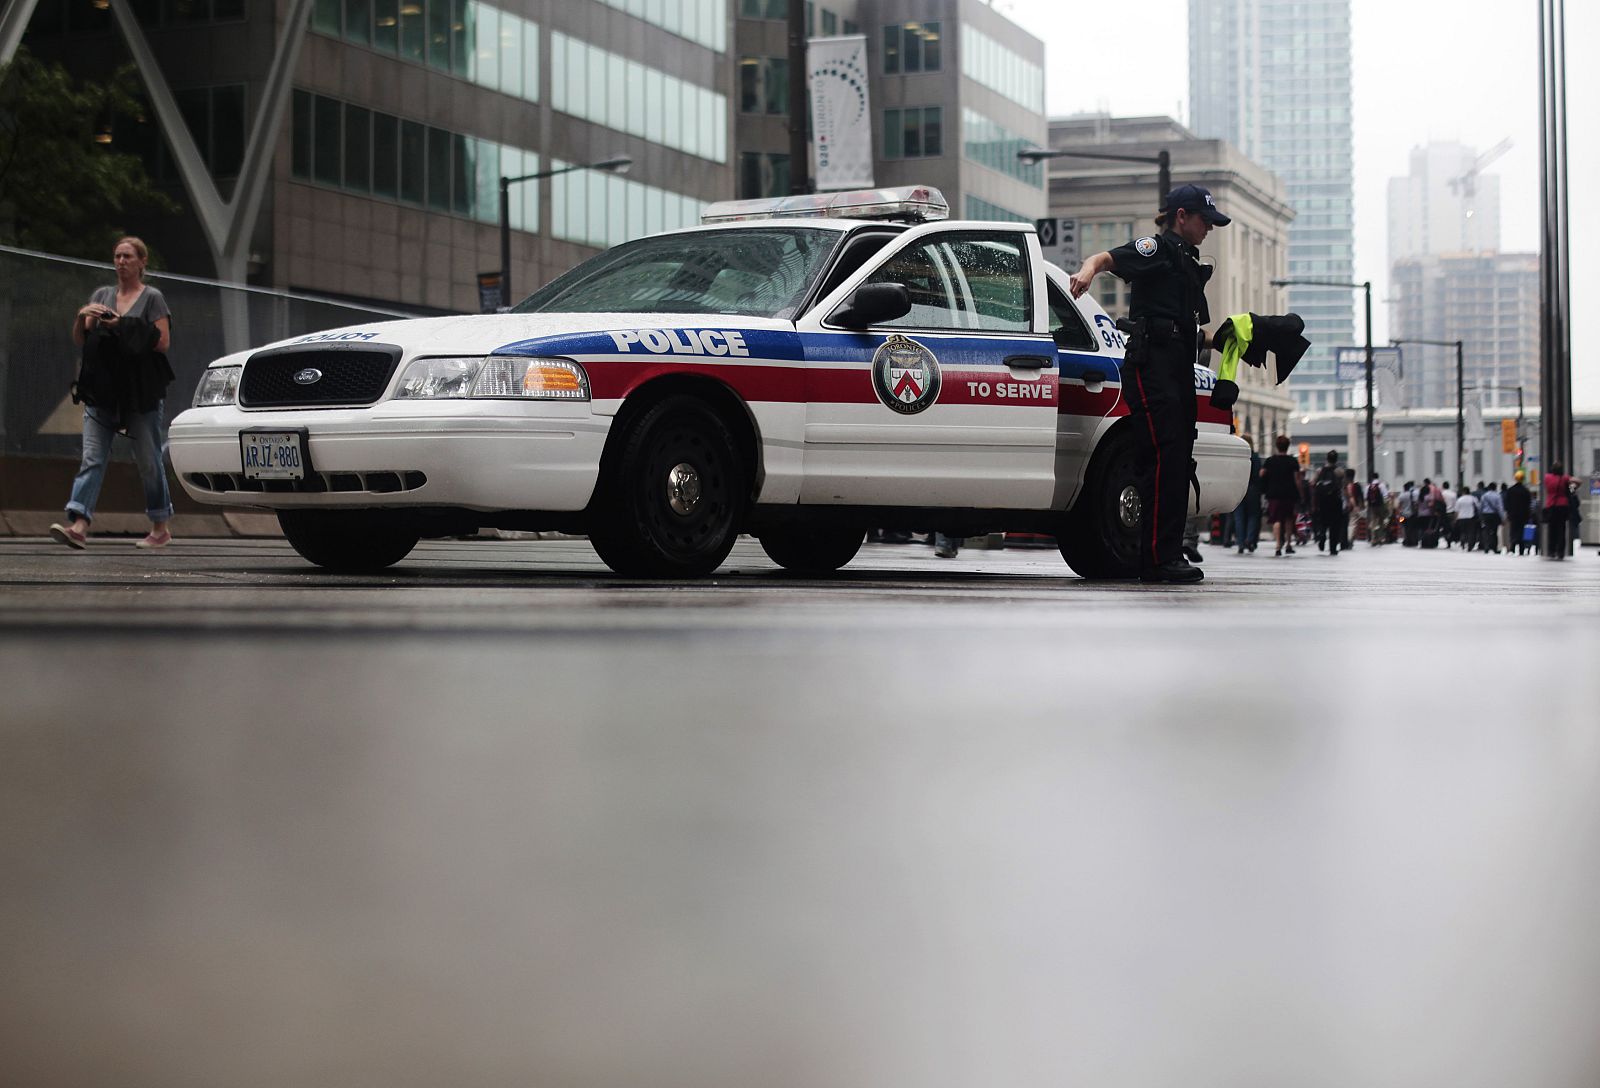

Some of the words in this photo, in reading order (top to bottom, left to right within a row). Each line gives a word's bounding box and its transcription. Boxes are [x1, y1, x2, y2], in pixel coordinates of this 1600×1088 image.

[608, 329, 749, 356] POLICE
[887, 343, 922, 354] TORONTO
[299, 371, 314, 381] Ford
[967, 382, 991, 397] TO
[996, 383, 1052, 399] SERVE
[895, 402, 920, 412] POLICE
[246, 444, 273, 467] ARJZ
[279, 446, 299, 467] 880
